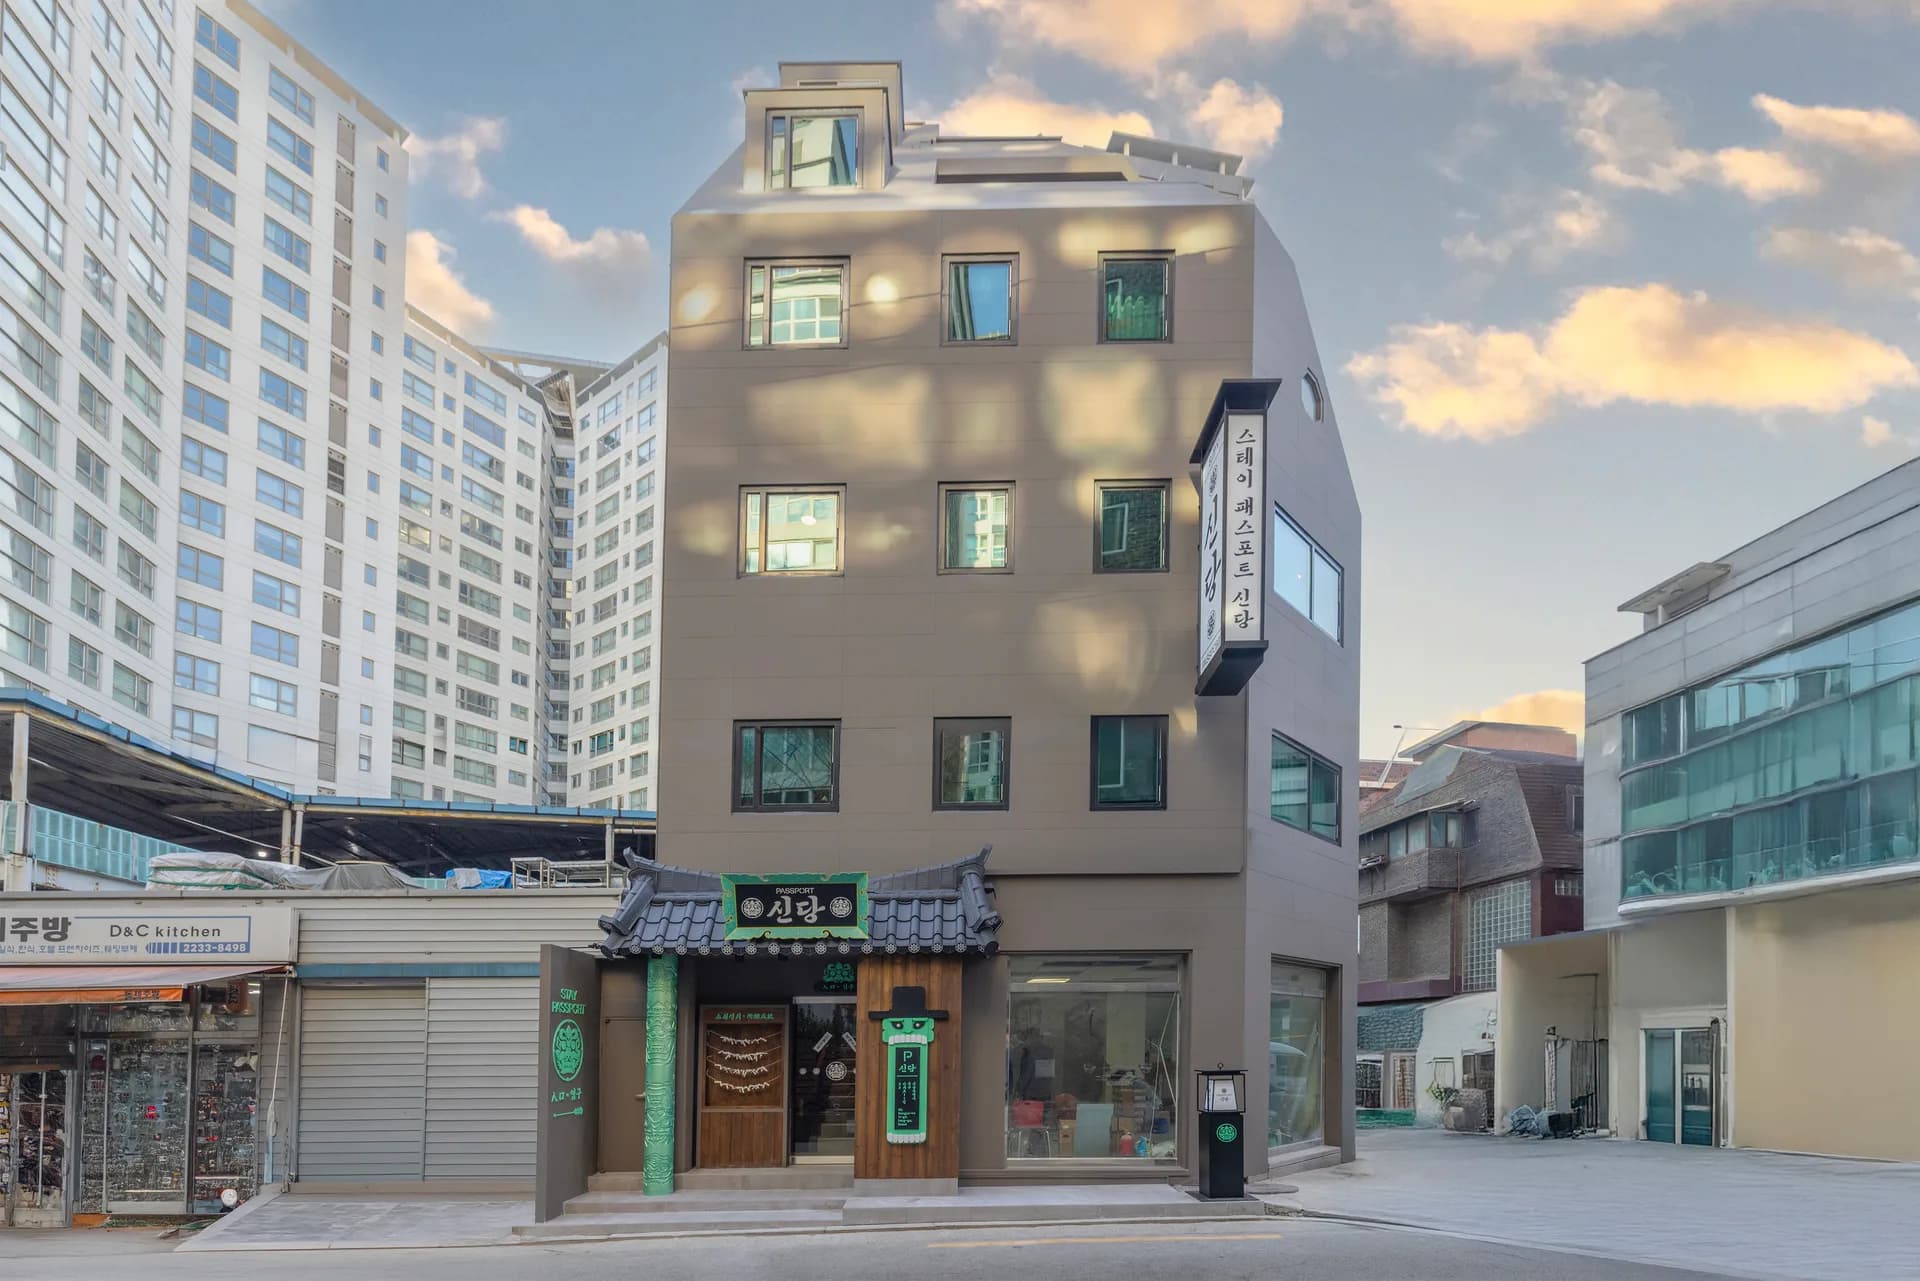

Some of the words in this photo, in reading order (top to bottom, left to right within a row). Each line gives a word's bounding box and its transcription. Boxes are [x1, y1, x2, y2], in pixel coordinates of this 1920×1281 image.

[1235, 428, 1257, 489] 스테이
[1204, 493, 1222, 603] 신당
[1233, 496, 1255, 579] 패스포트
[1231, 588, 1255, 629] 신당
[775, 887, 815, 895] PASSPORT
[766, 895, 826, 924] 신당
[0, 916, 72, 943] 주방
[110, 924, 149, 938] D&C
[155, 925, 221, 938] kitchen
[183, 943, 247, 953] 2233-8498
[551, 1001, 586, 1015] PASSPORT
[560, 988, 578, 1001] STAY
